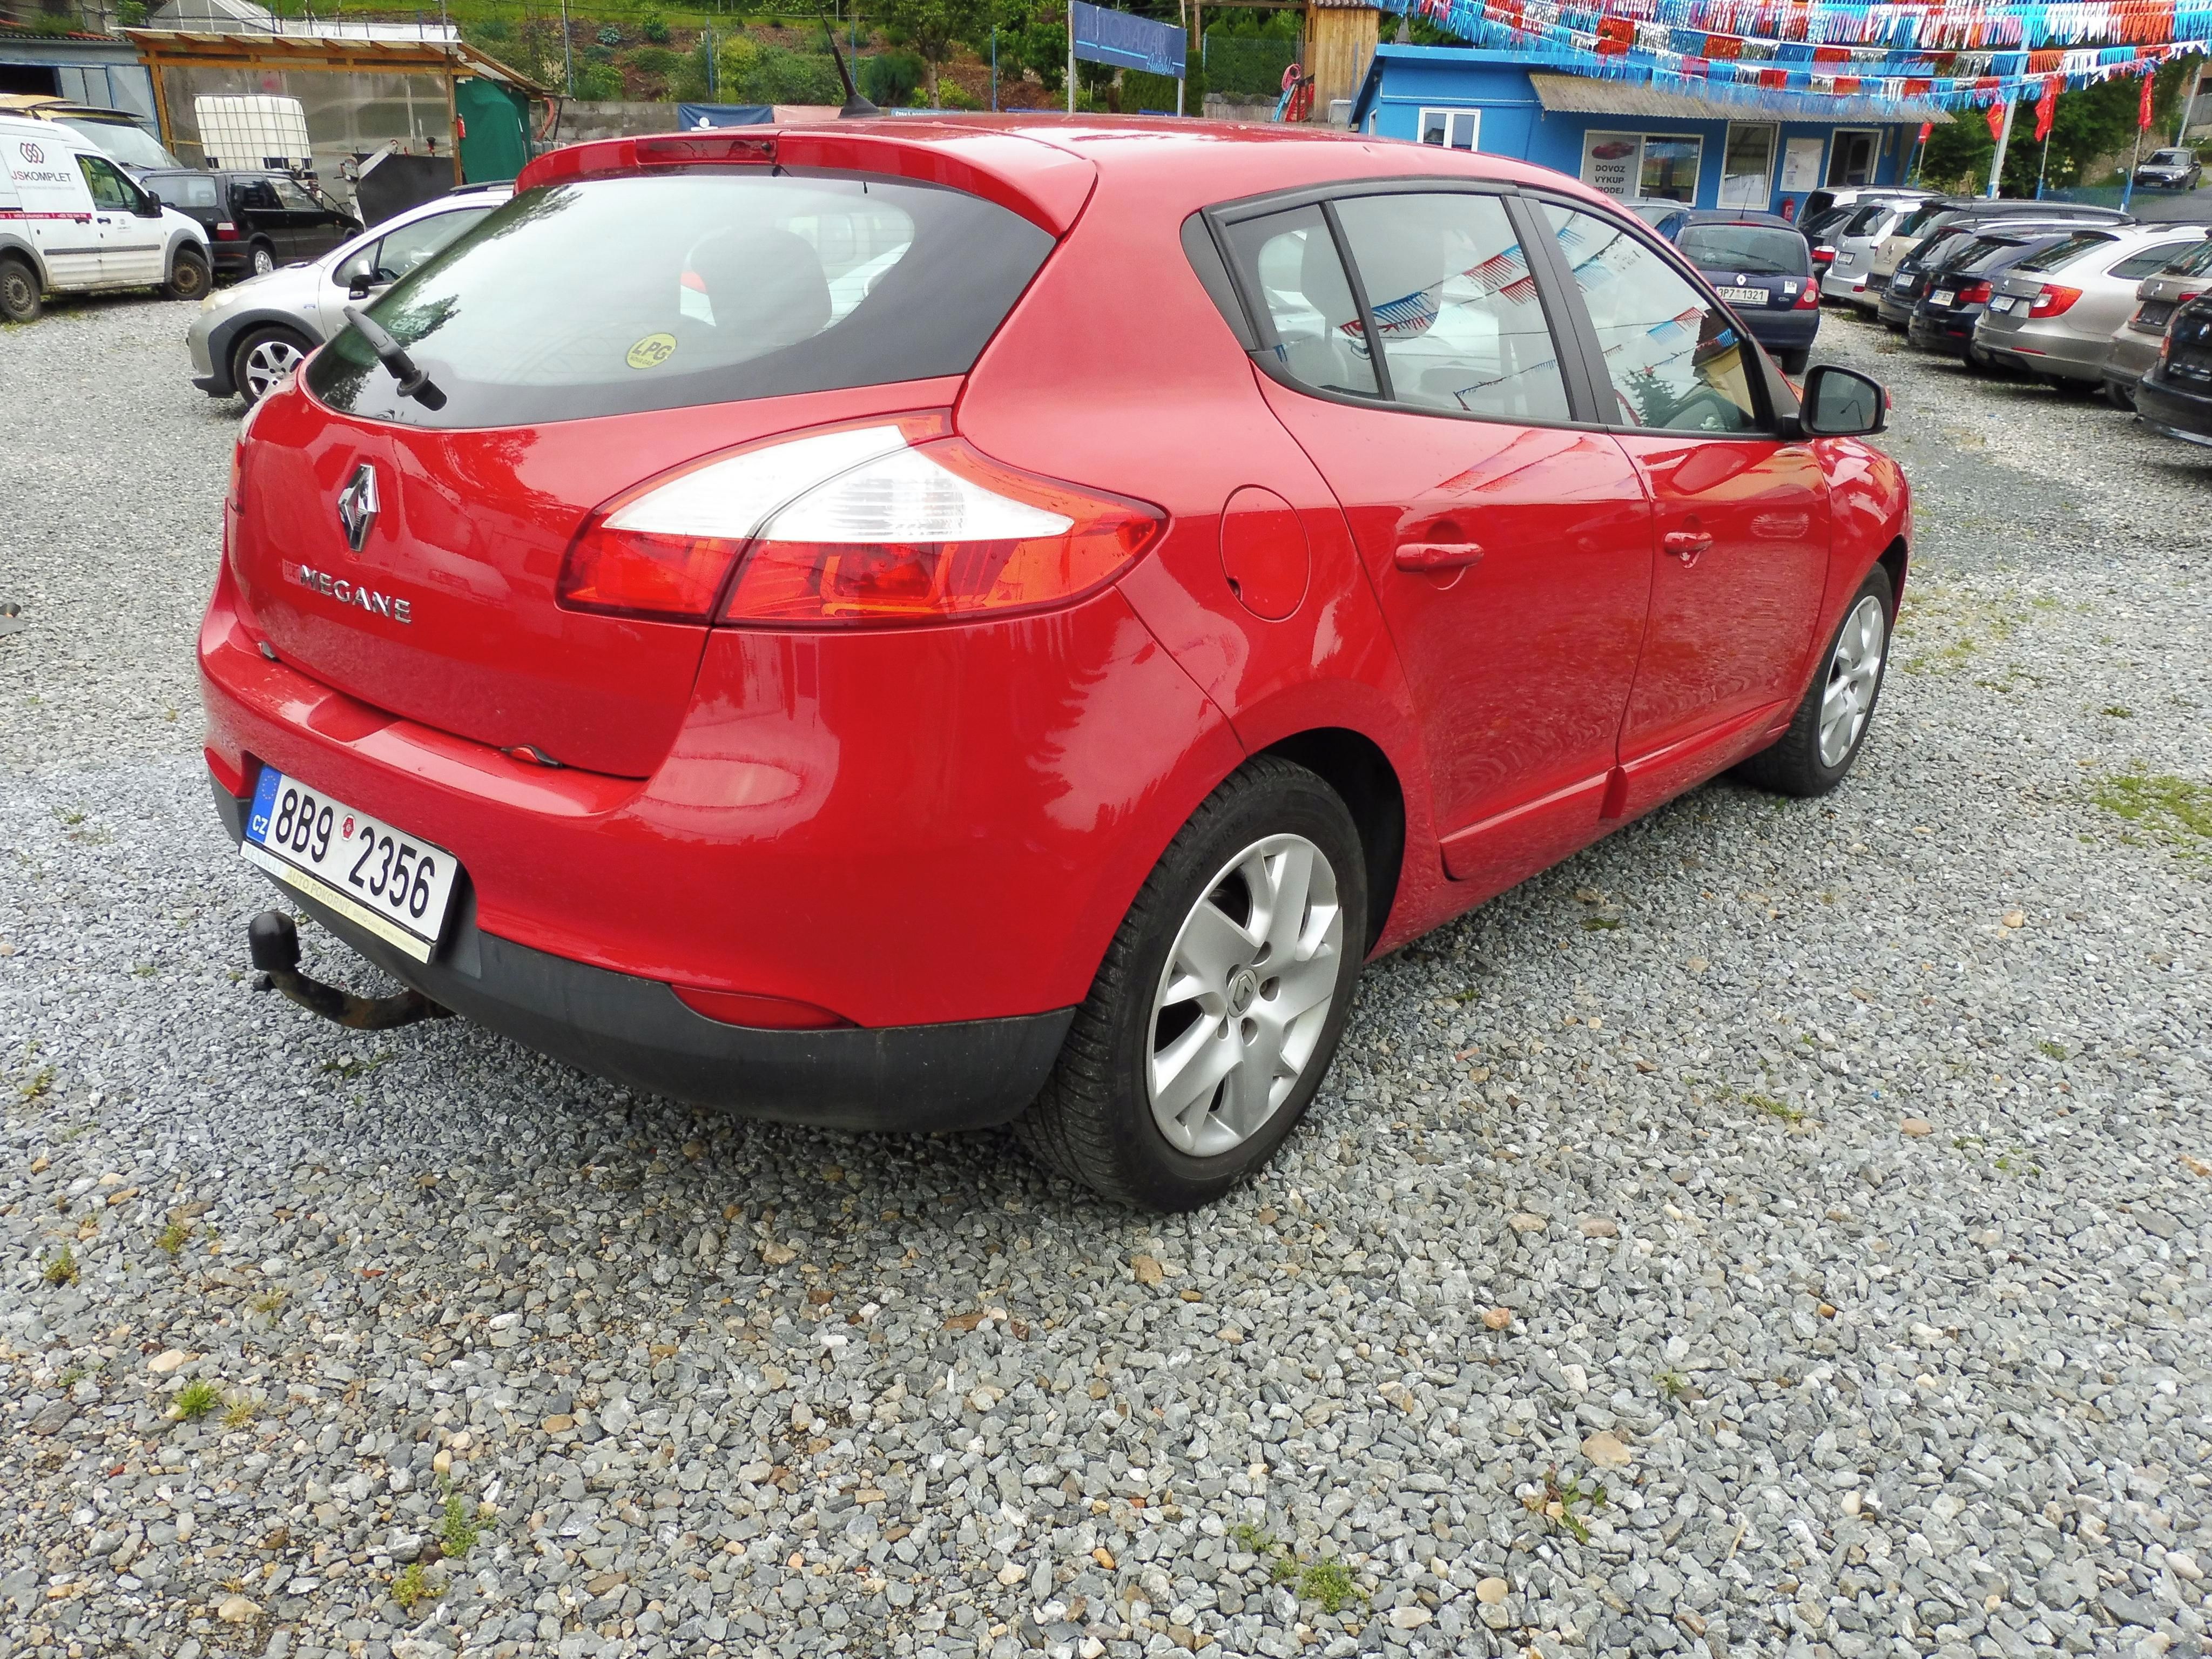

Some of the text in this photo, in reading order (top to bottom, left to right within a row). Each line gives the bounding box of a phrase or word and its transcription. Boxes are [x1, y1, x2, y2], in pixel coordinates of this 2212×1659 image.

[11, 170, 71, 183] JSKOMPLET
[1595, 165, 1626, 173] DOVOZ
[1595, 175, 1624, 184] VÝKUP
[1715, 288, 1764, 301] 3P7 1321
[632, 340, 672, 361] LPG
[300, 564, 412, 624] MEGANE
[252, 814, 269, 835] CZ
[275, 788, 435, 919] 8B9 2356
[244, 844, 284, 875] RENAULT
[286, 869, 309, 889] AUTO
[309, 883, 350, 914] POKORNÝ
